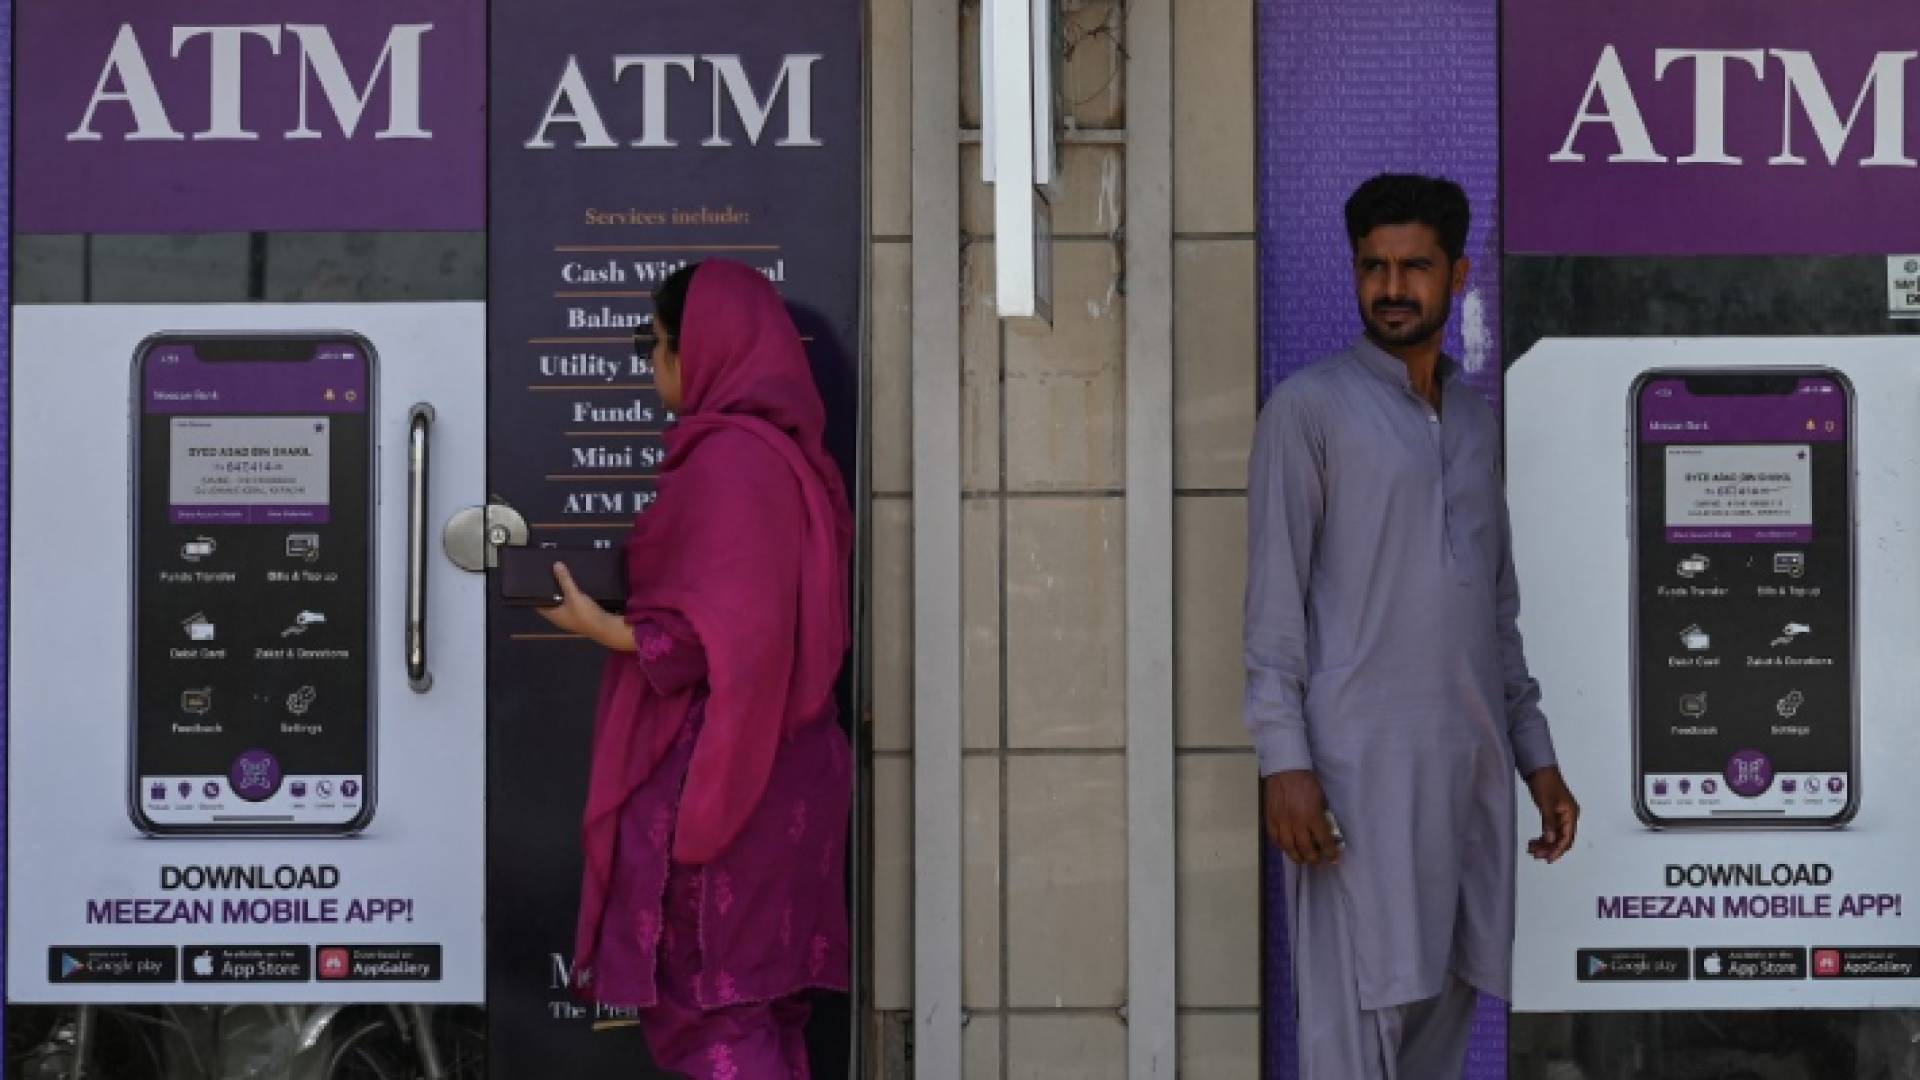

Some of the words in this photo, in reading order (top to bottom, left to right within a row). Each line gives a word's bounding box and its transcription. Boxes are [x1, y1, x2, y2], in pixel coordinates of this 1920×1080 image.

[66, 23, 435, 141] ATM
[523, 53, 824, 149] ATM
[1549, 43, 1918, 167] ATM
[585, 207, 666, 225] Services
[672, 205, 749, 225] include:
[561, 260, 625, 284] Cash
[538, 353, 621, 383] Utility
[573, 399, 654, 423] Funds
[571, 446, 633, 469] Mini
[561, 492, 625, 514] ATM
[172, 723, 223, 734] Feedback
[160, 865, 340, 890] DOWNLOAD
[1664, 863, 1833, 888] DOWNLOAD
[86, 898, 214, 924] MEEZAN
[221, 898, 339, 924] MOBILE
[345, 898, 415, 924] APP!
[1596, 896, 1716, 920] MEEZAN
[1722, 895, 1832, 919] MOBILE
[1838, 893, 1902, 917] APP!
[87, 958, 132, 976] Google
[221, 960, 256, 979] App
[257, 960, 301, 976] Store
[353, 960, 430, 978] AppGallery
[1727, 960, 1758, 978] App
[1760, 960, 1798, 976] Store
[1844, 960, 1912, 977] AppGallery
